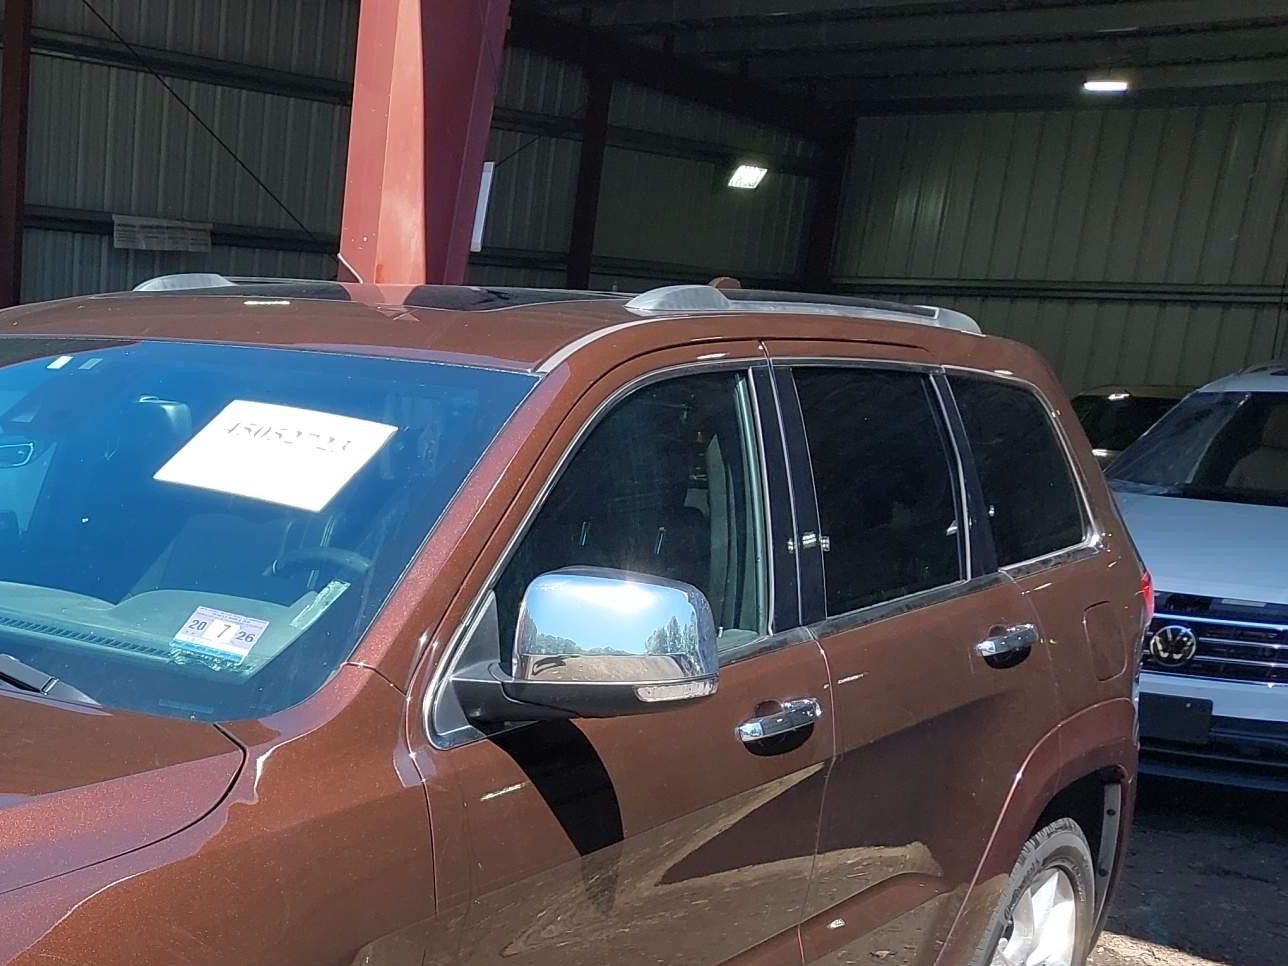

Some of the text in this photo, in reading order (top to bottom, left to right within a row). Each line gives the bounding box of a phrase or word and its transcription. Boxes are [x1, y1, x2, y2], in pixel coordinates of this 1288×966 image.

[188, 619, 255, 642] 20 7 26
